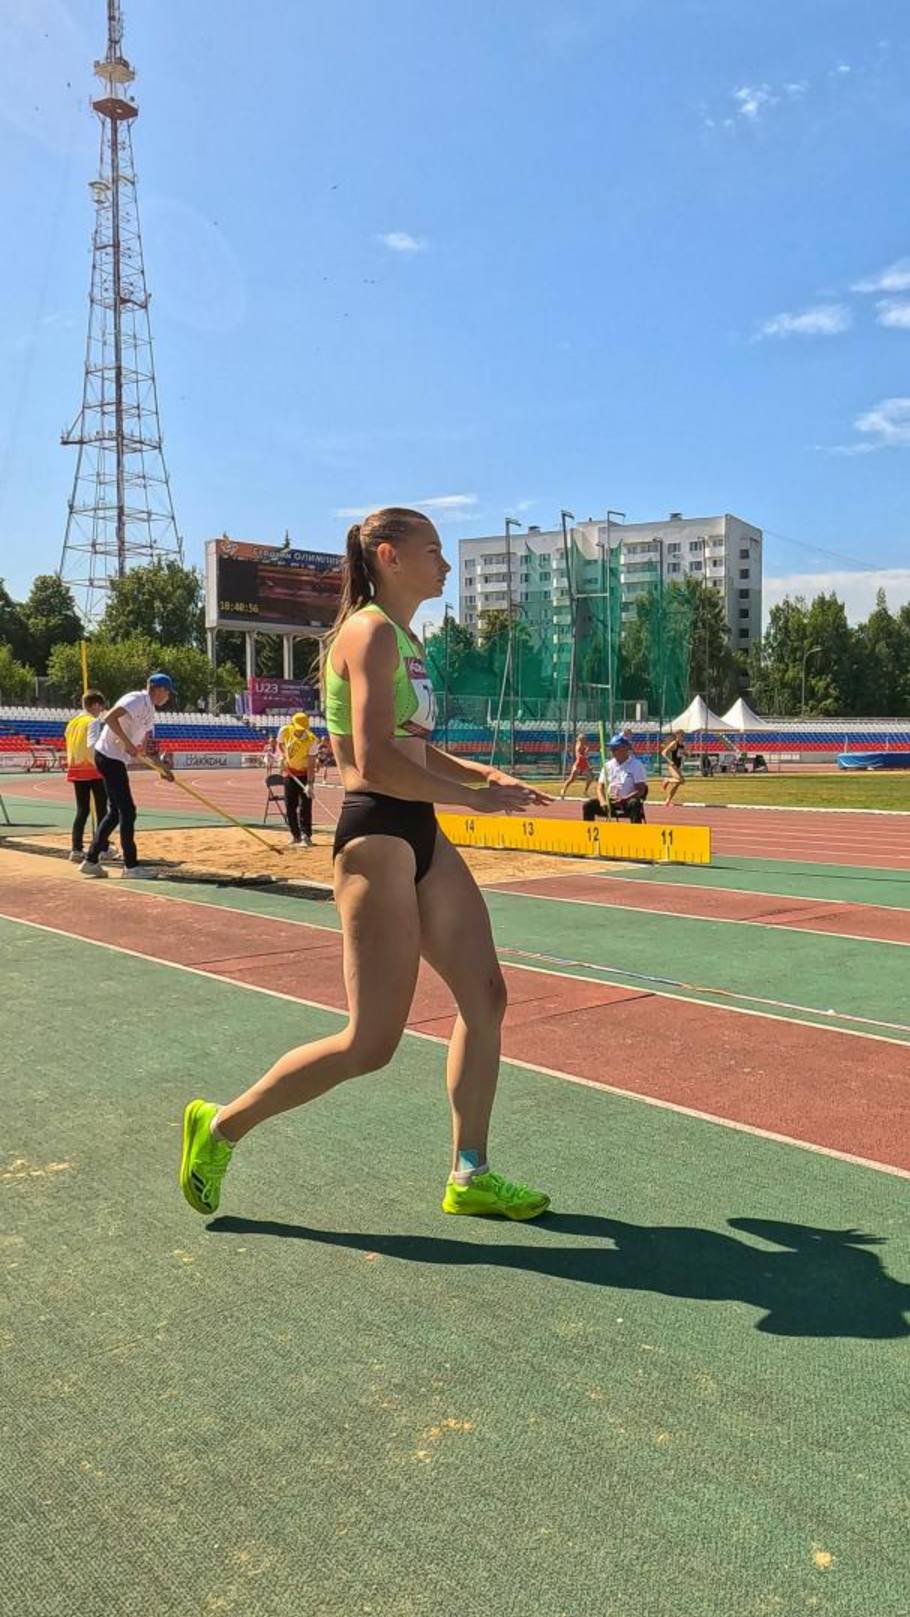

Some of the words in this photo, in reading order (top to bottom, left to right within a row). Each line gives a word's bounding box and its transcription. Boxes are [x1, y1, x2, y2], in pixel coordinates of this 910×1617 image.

[255, 682, 279, 694] U23
[465, 820, 475, 833] 14
[523, 822, 535, 837] 13
[587, 827, 600, 842] 12
[661, 830, 674, 845] 11
